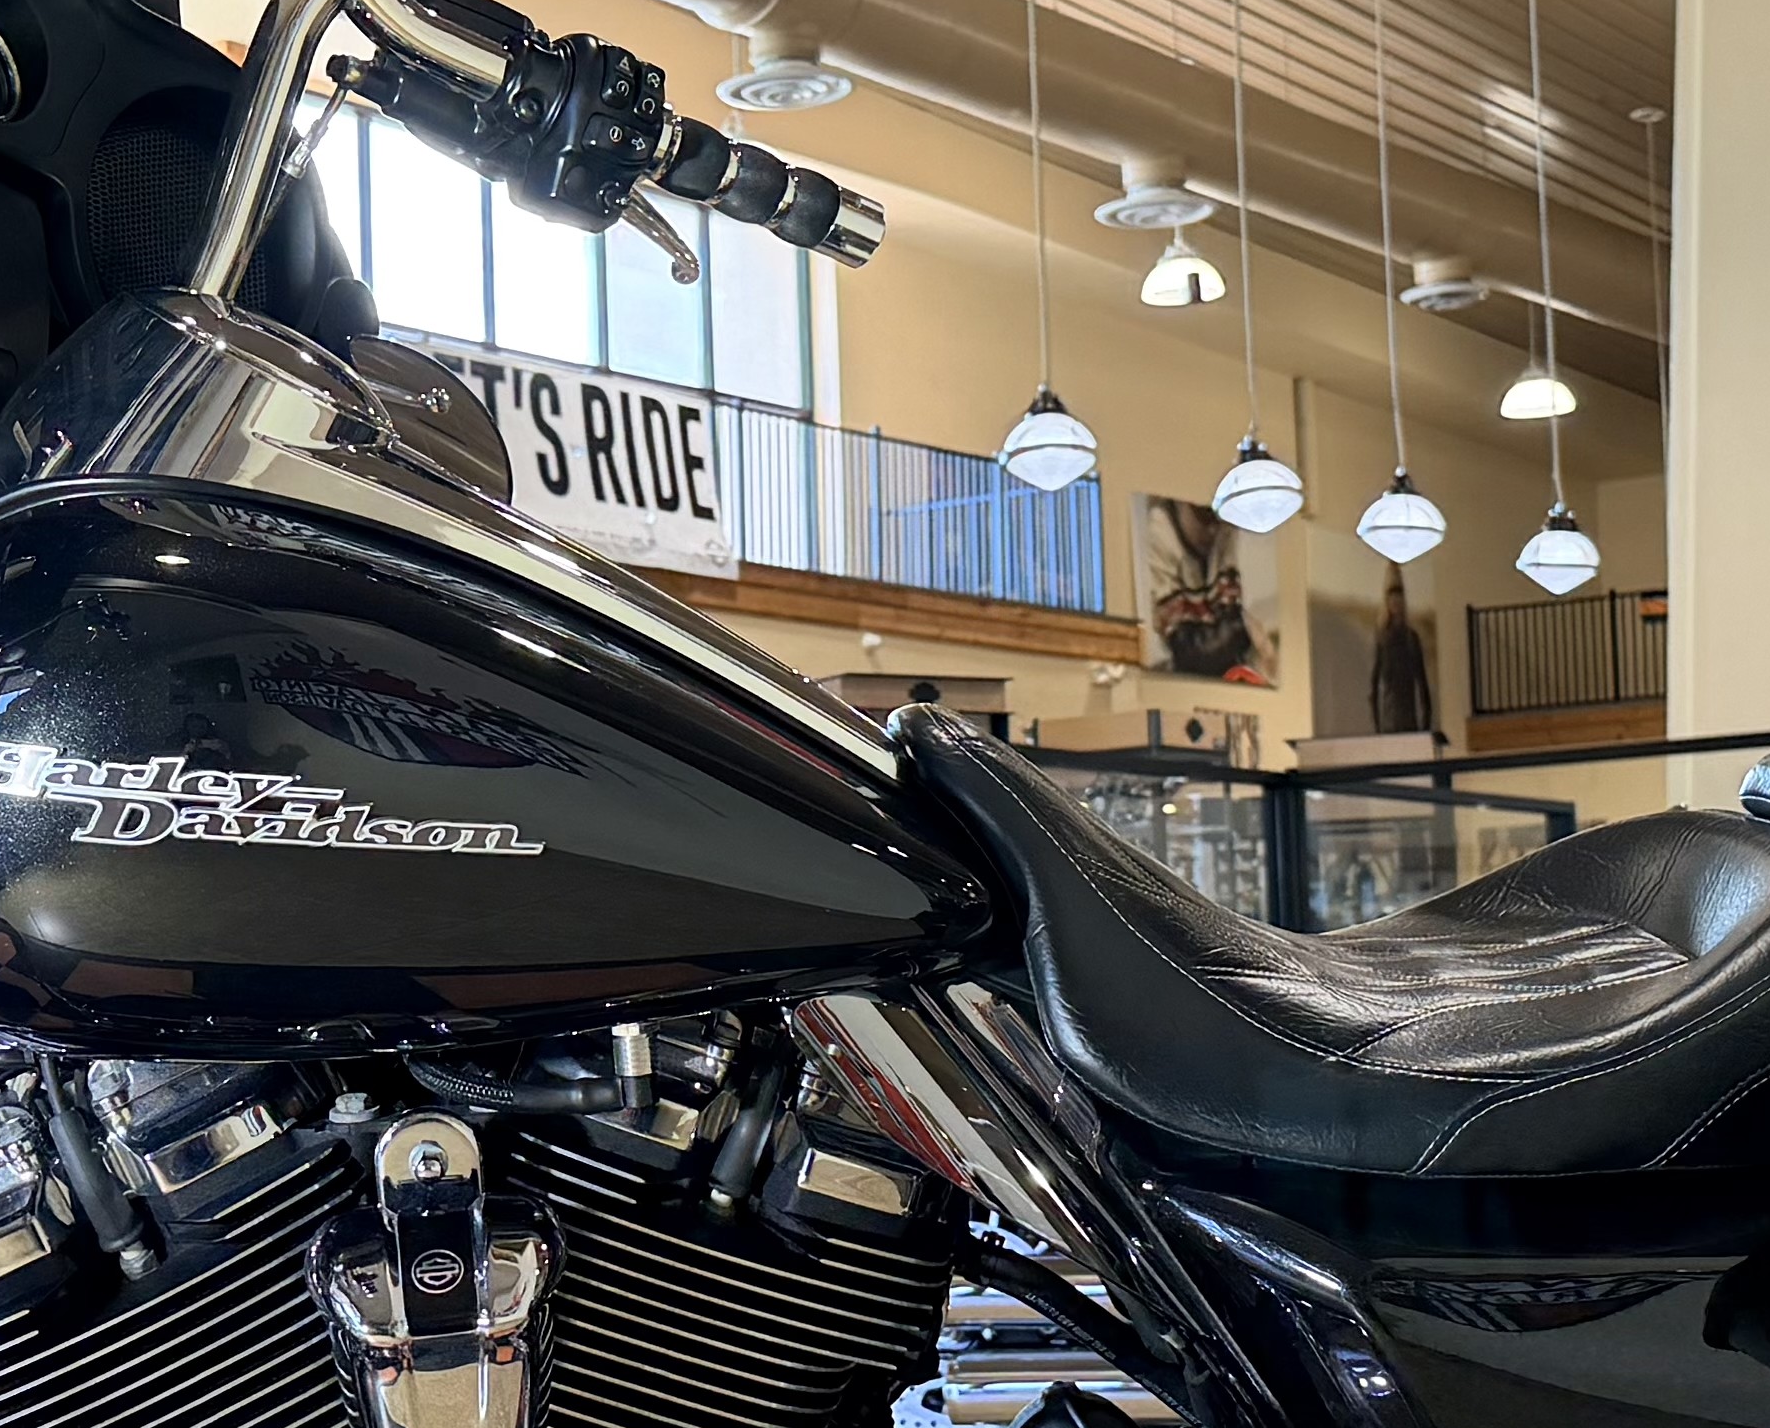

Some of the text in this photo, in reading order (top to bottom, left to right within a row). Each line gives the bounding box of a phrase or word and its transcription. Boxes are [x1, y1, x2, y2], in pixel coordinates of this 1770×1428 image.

[432, 352, 716, 521] T'S RIDE
[49, 794, 545, 855] Davidson
